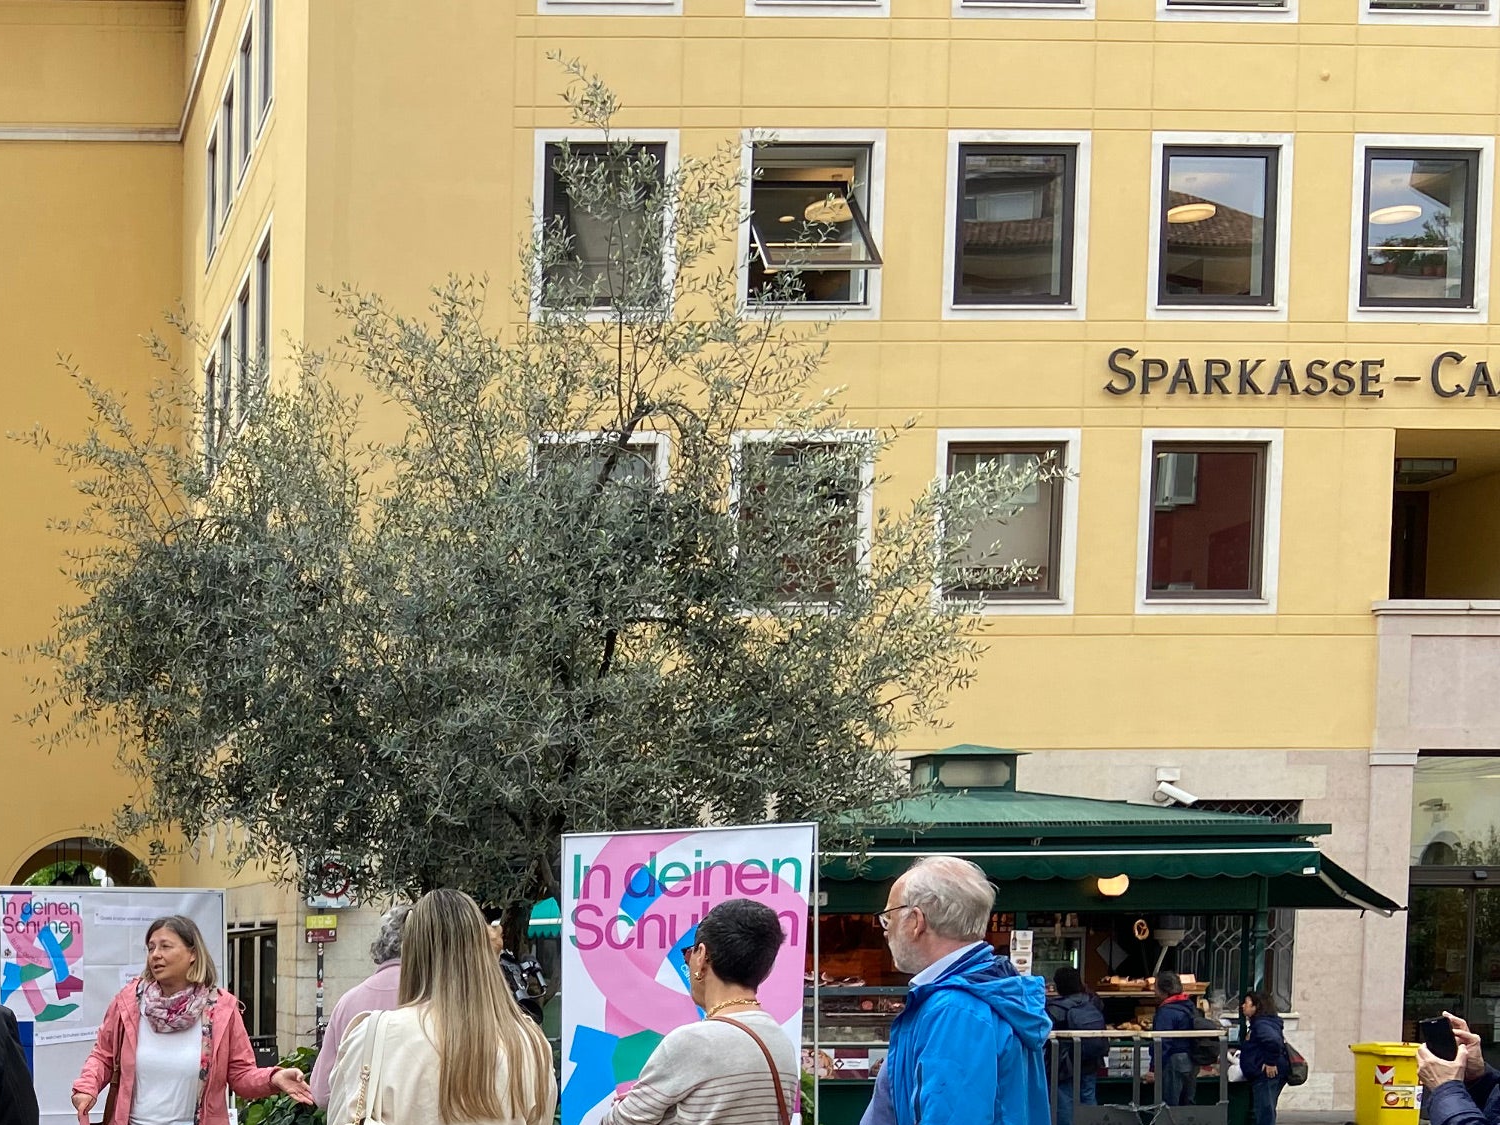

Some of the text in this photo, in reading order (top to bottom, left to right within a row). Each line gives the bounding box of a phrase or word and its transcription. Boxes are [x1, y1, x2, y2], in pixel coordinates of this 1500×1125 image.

[572, 849, 802, 900] In deinen
[2, 897, 80, 916] In deinen
[2, 916, 81, 934] Schuhen
[569, 902, 799, 951] Schun
